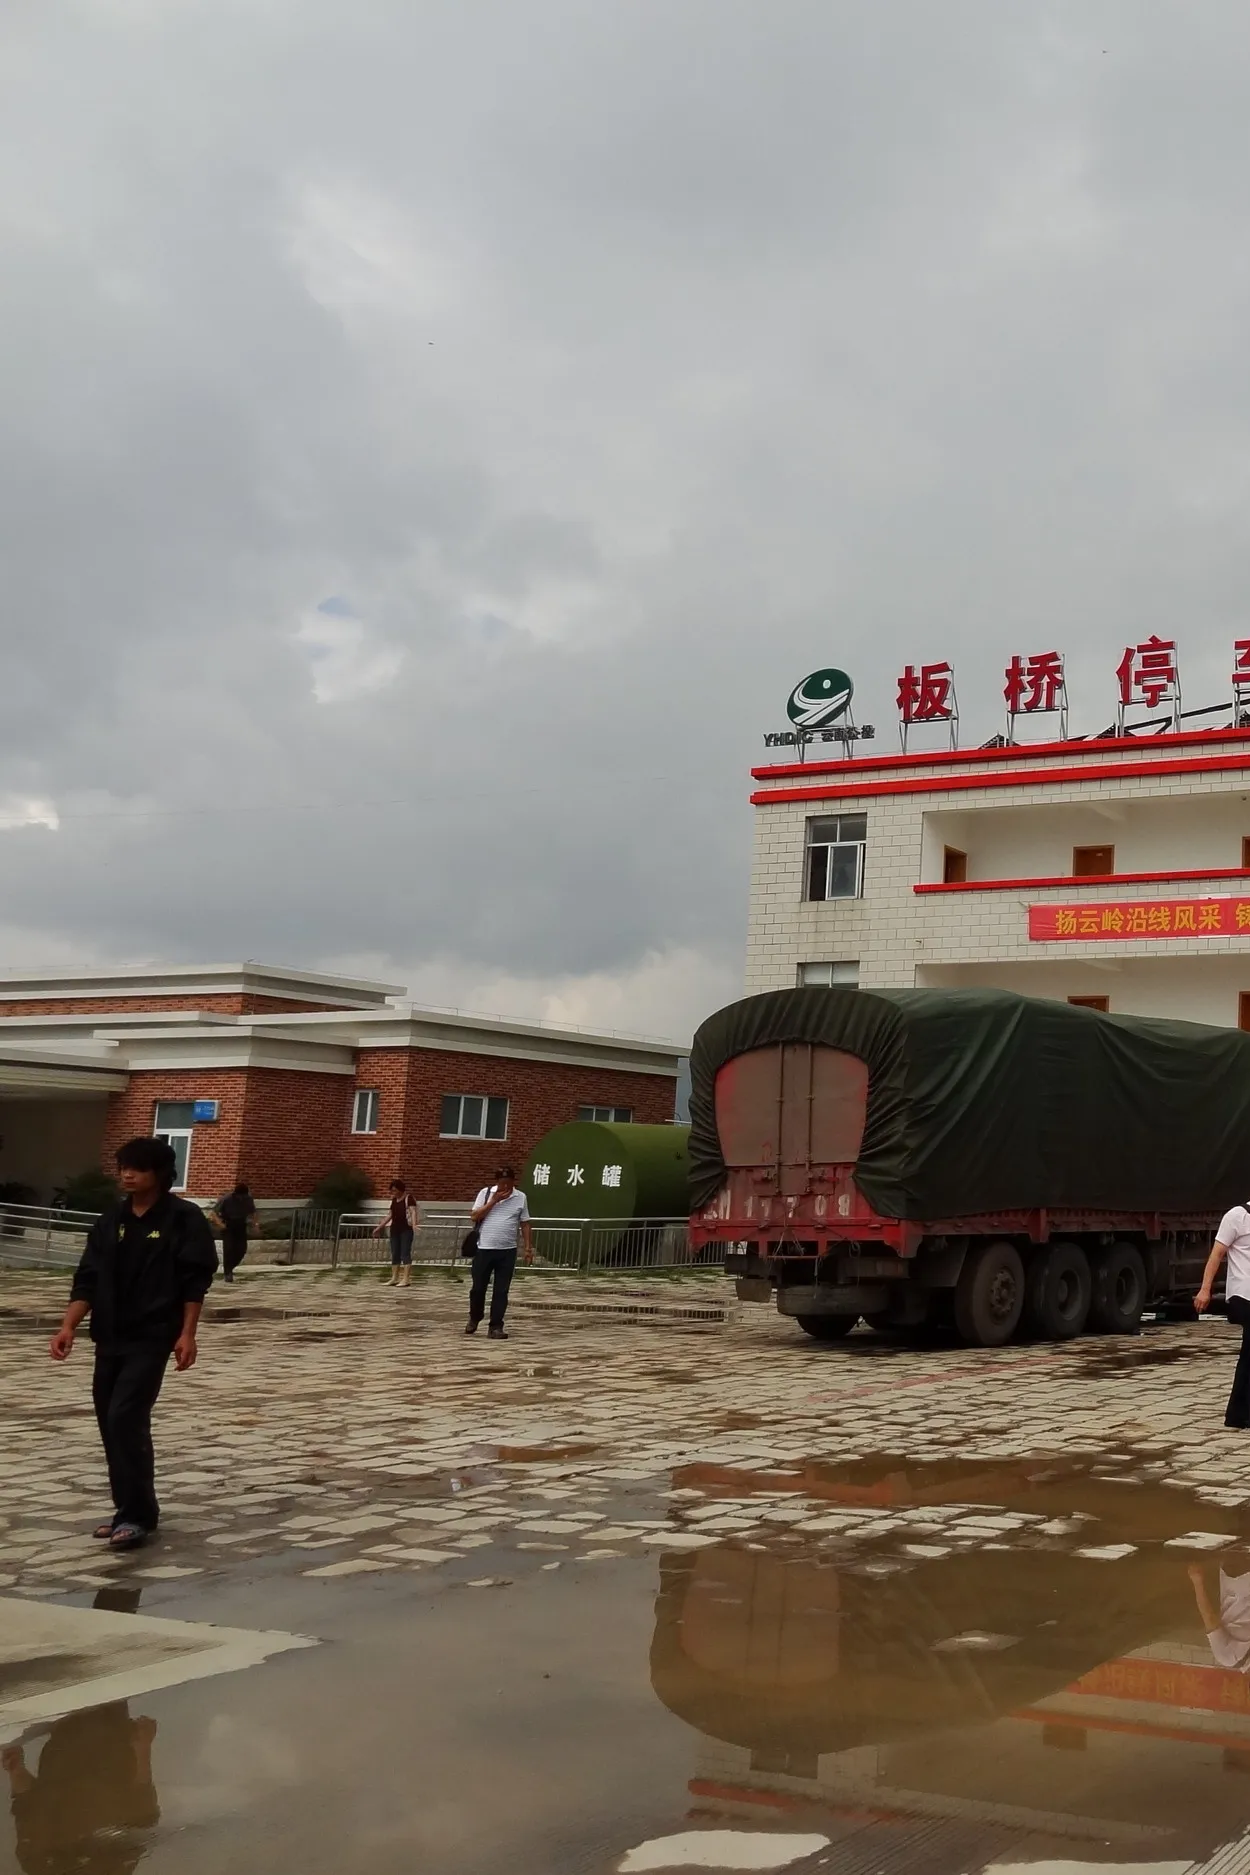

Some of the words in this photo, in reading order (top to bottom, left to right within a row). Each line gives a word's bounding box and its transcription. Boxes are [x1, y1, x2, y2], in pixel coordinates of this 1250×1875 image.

[1055, 903, 1222, 935] 扬云岭沿线风采
[533, 1163, 622, 1188] 储水罐
